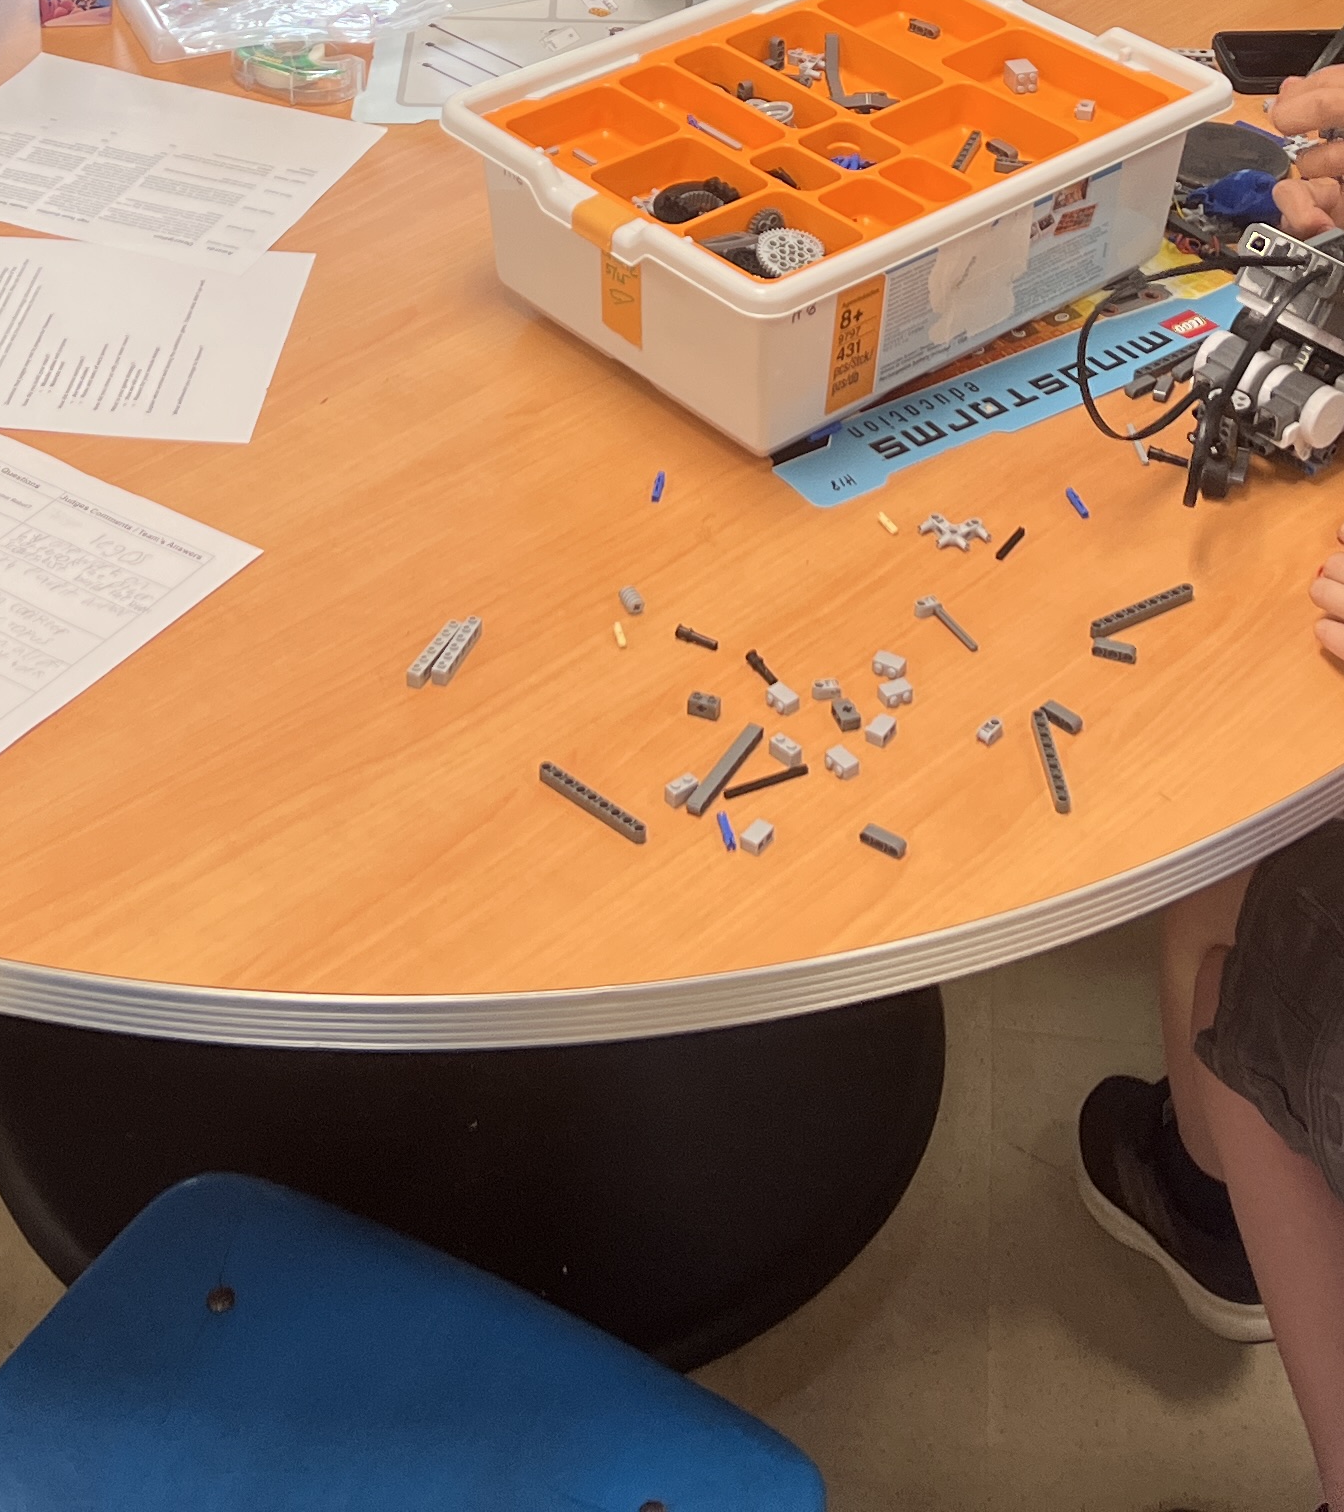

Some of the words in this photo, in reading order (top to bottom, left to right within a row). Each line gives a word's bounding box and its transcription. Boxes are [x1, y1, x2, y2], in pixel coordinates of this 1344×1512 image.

[839, 309, 864, 331] 8+
[836, 341, 862, 362] 431
[846, 380, 981, 440] education
[0, 467, 41, 490] Questions
[59, 494, 90, 512] Judges
[89, 507, 133, 531] Comments
